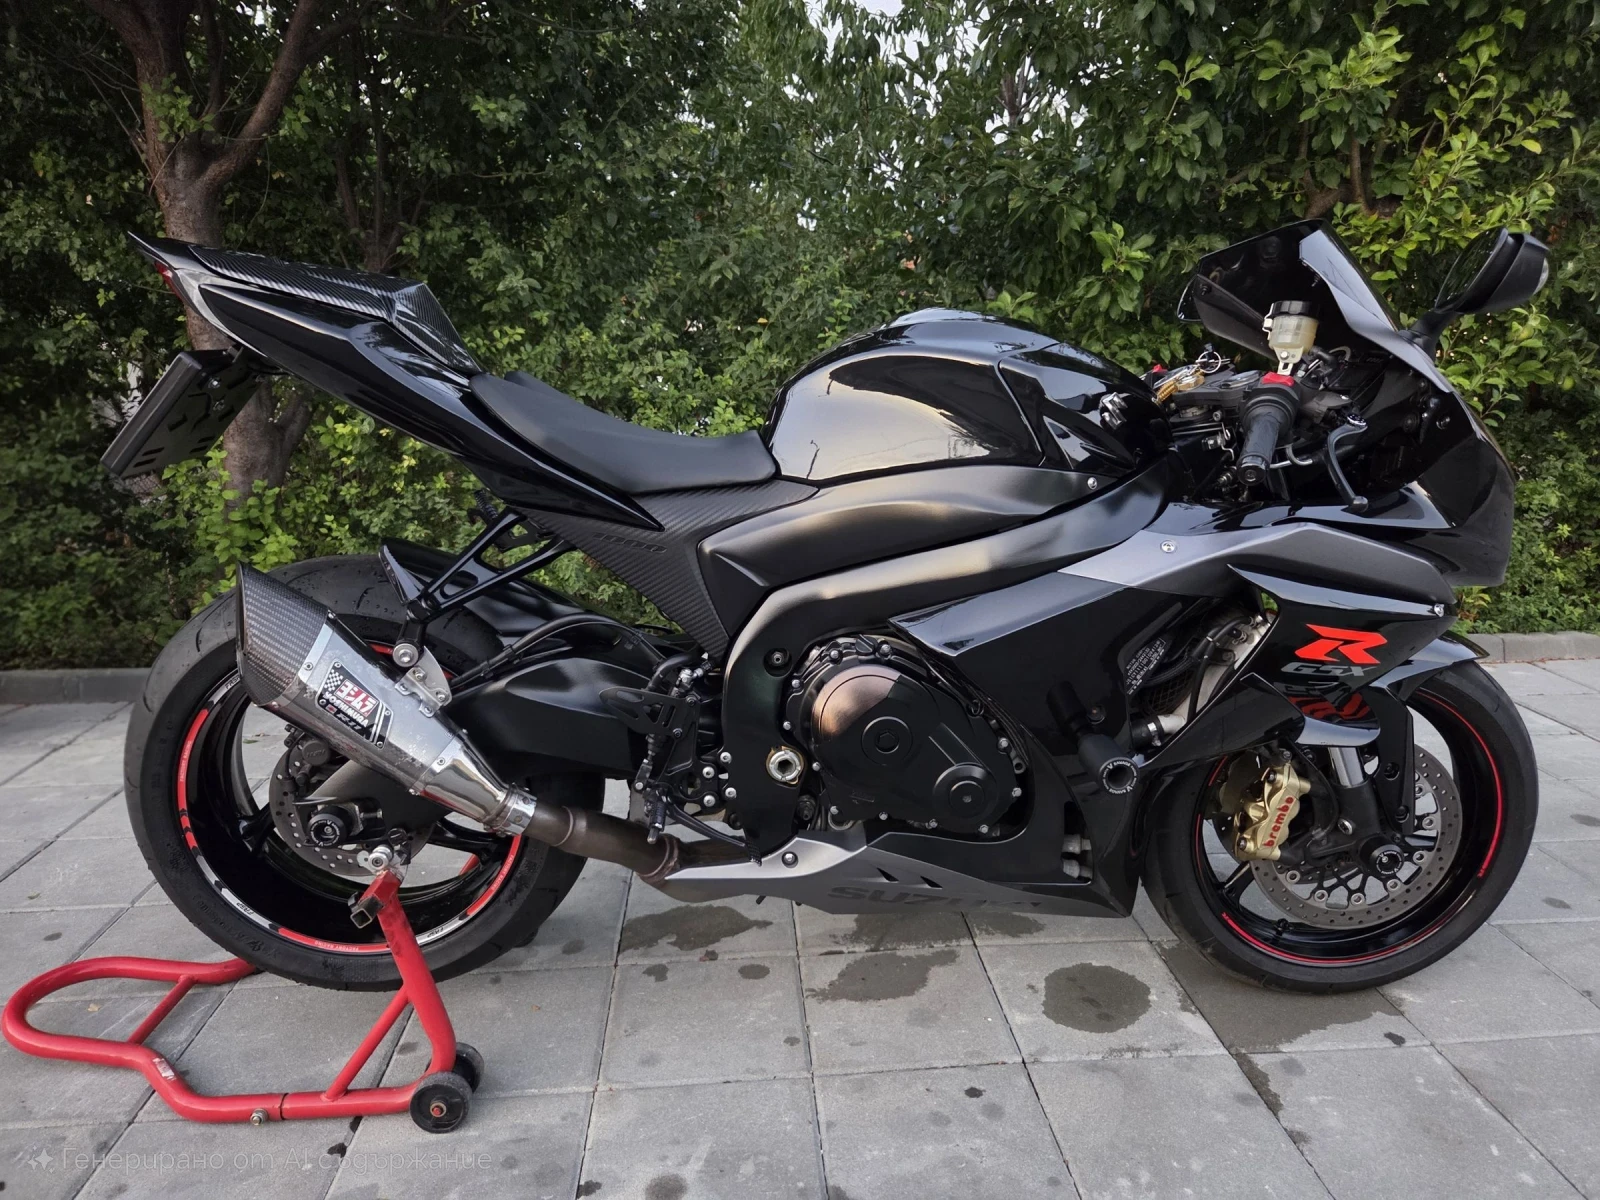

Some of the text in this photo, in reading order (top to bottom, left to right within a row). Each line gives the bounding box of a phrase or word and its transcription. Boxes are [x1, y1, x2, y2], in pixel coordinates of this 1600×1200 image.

[1294, 624, 1388, 664] R
[1280, 662, 1377, 677] GSX
[323, 692, 369, 727] YOSHIMURA
[336, 681, 377, 714] ヨシムラ
[1264, 796, 1294, 847] brembo
